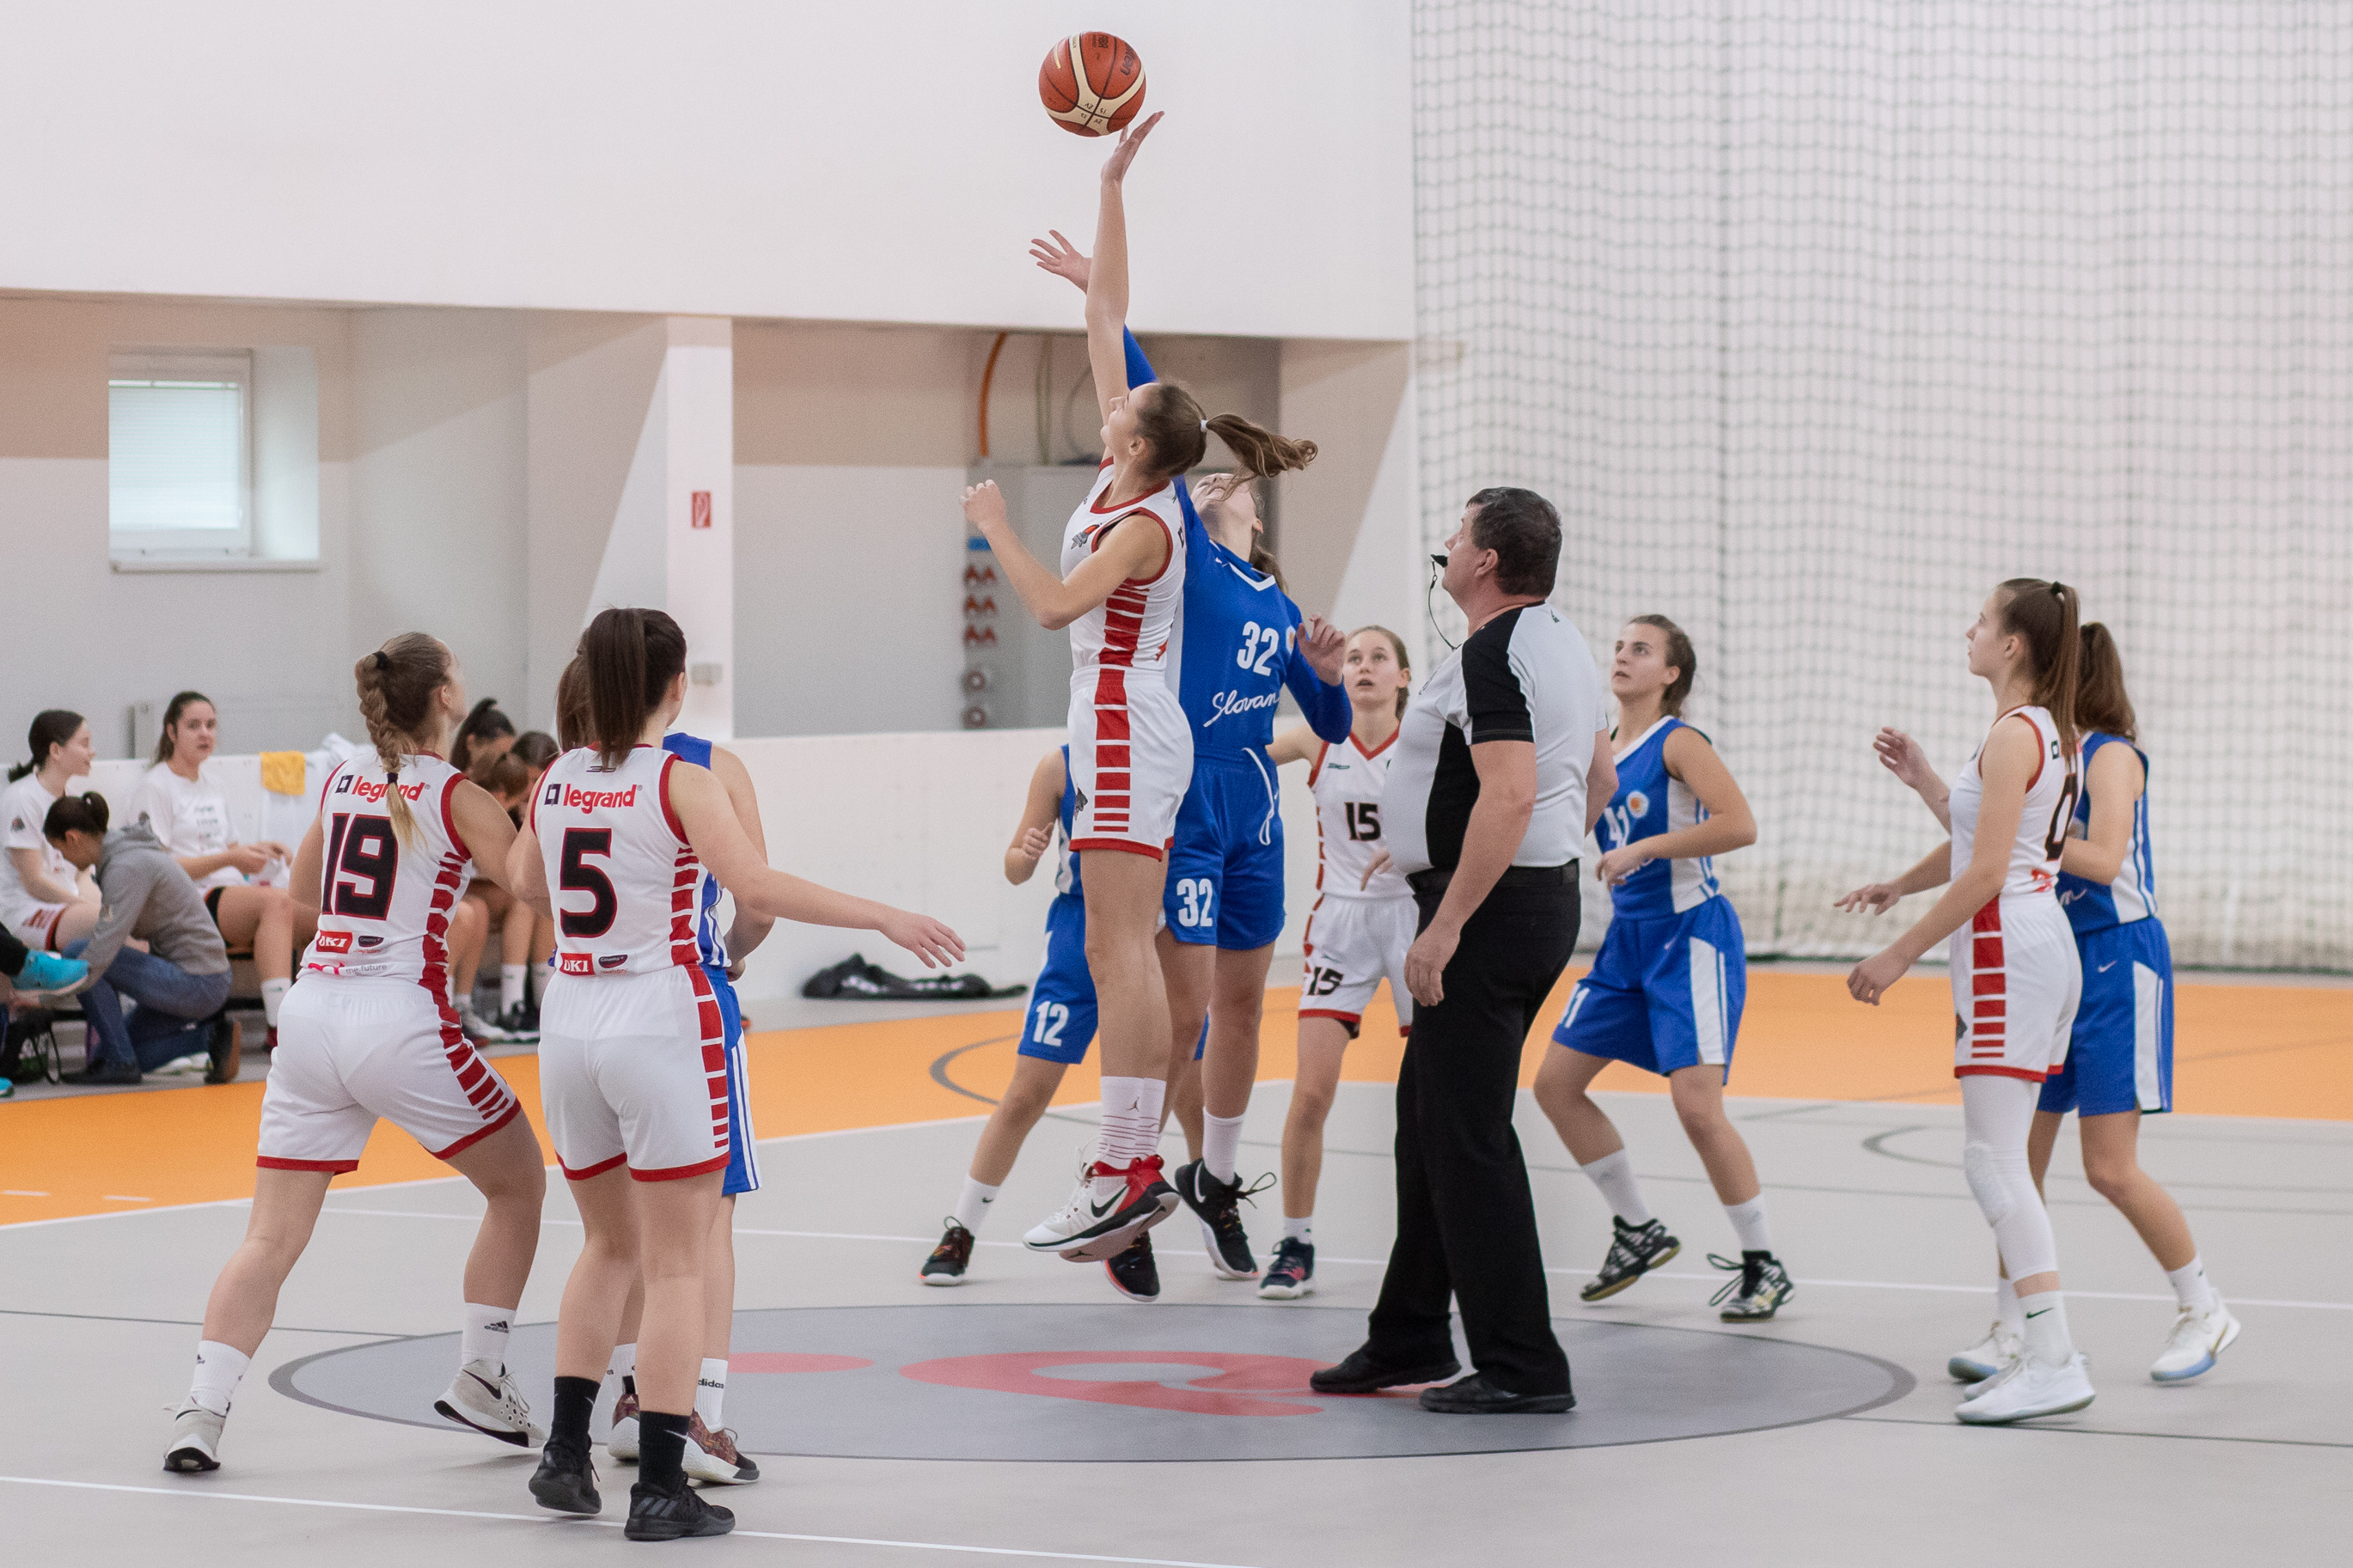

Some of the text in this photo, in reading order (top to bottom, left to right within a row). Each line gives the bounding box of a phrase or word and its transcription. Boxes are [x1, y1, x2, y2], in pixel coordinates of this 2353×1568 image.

[1237, 620, 1280, 676] 32
[1203, 689, 1280, 728] Slovan
[351, 775, 425, 803] legrnd
[563, 783, 638, 815] legrand
[1344, 802, 1382, 841] 15
[321, 812, 399, 921] 19
[559, 827, 618, 938] 5
[1176, 878, 1213, 926] 32
[361, 963, 388, 972] future
[1307, 967, 1344, 996] 15
[1033, 1000, 1070, 1046] 12
[697, 1378, 724, 1388] didas
